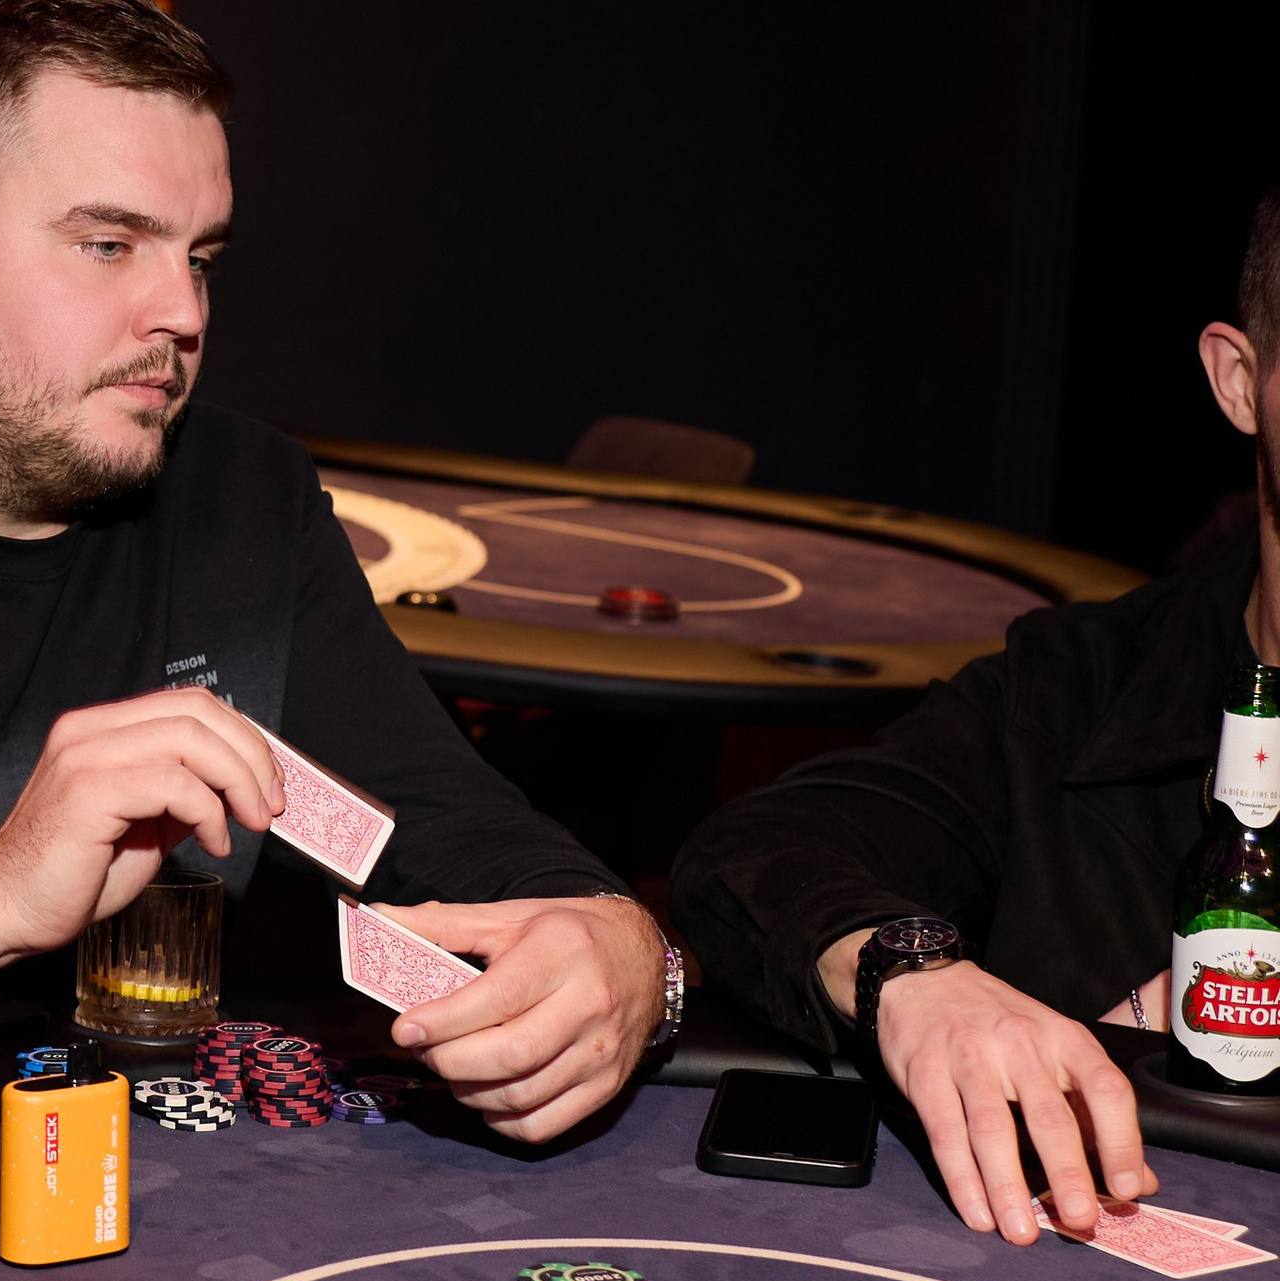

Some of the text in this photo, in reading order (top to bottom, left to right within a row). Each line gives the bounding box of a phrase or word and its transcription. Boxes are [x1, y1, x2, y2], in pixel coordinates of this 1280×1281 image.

[166, 653, 207, 676] DESIGN
[1216, 950, 1241, 962] ANNO
[1200, 1001, 1280, 1026] ARTOI
[1211, 1040, 1274, 1062] Belgium
[46, 1115, 58, 1196] JOY STICK
[104, 1173, 118, 1242] BIGGIE
[95, 1204, 104, 1244] GRAND
